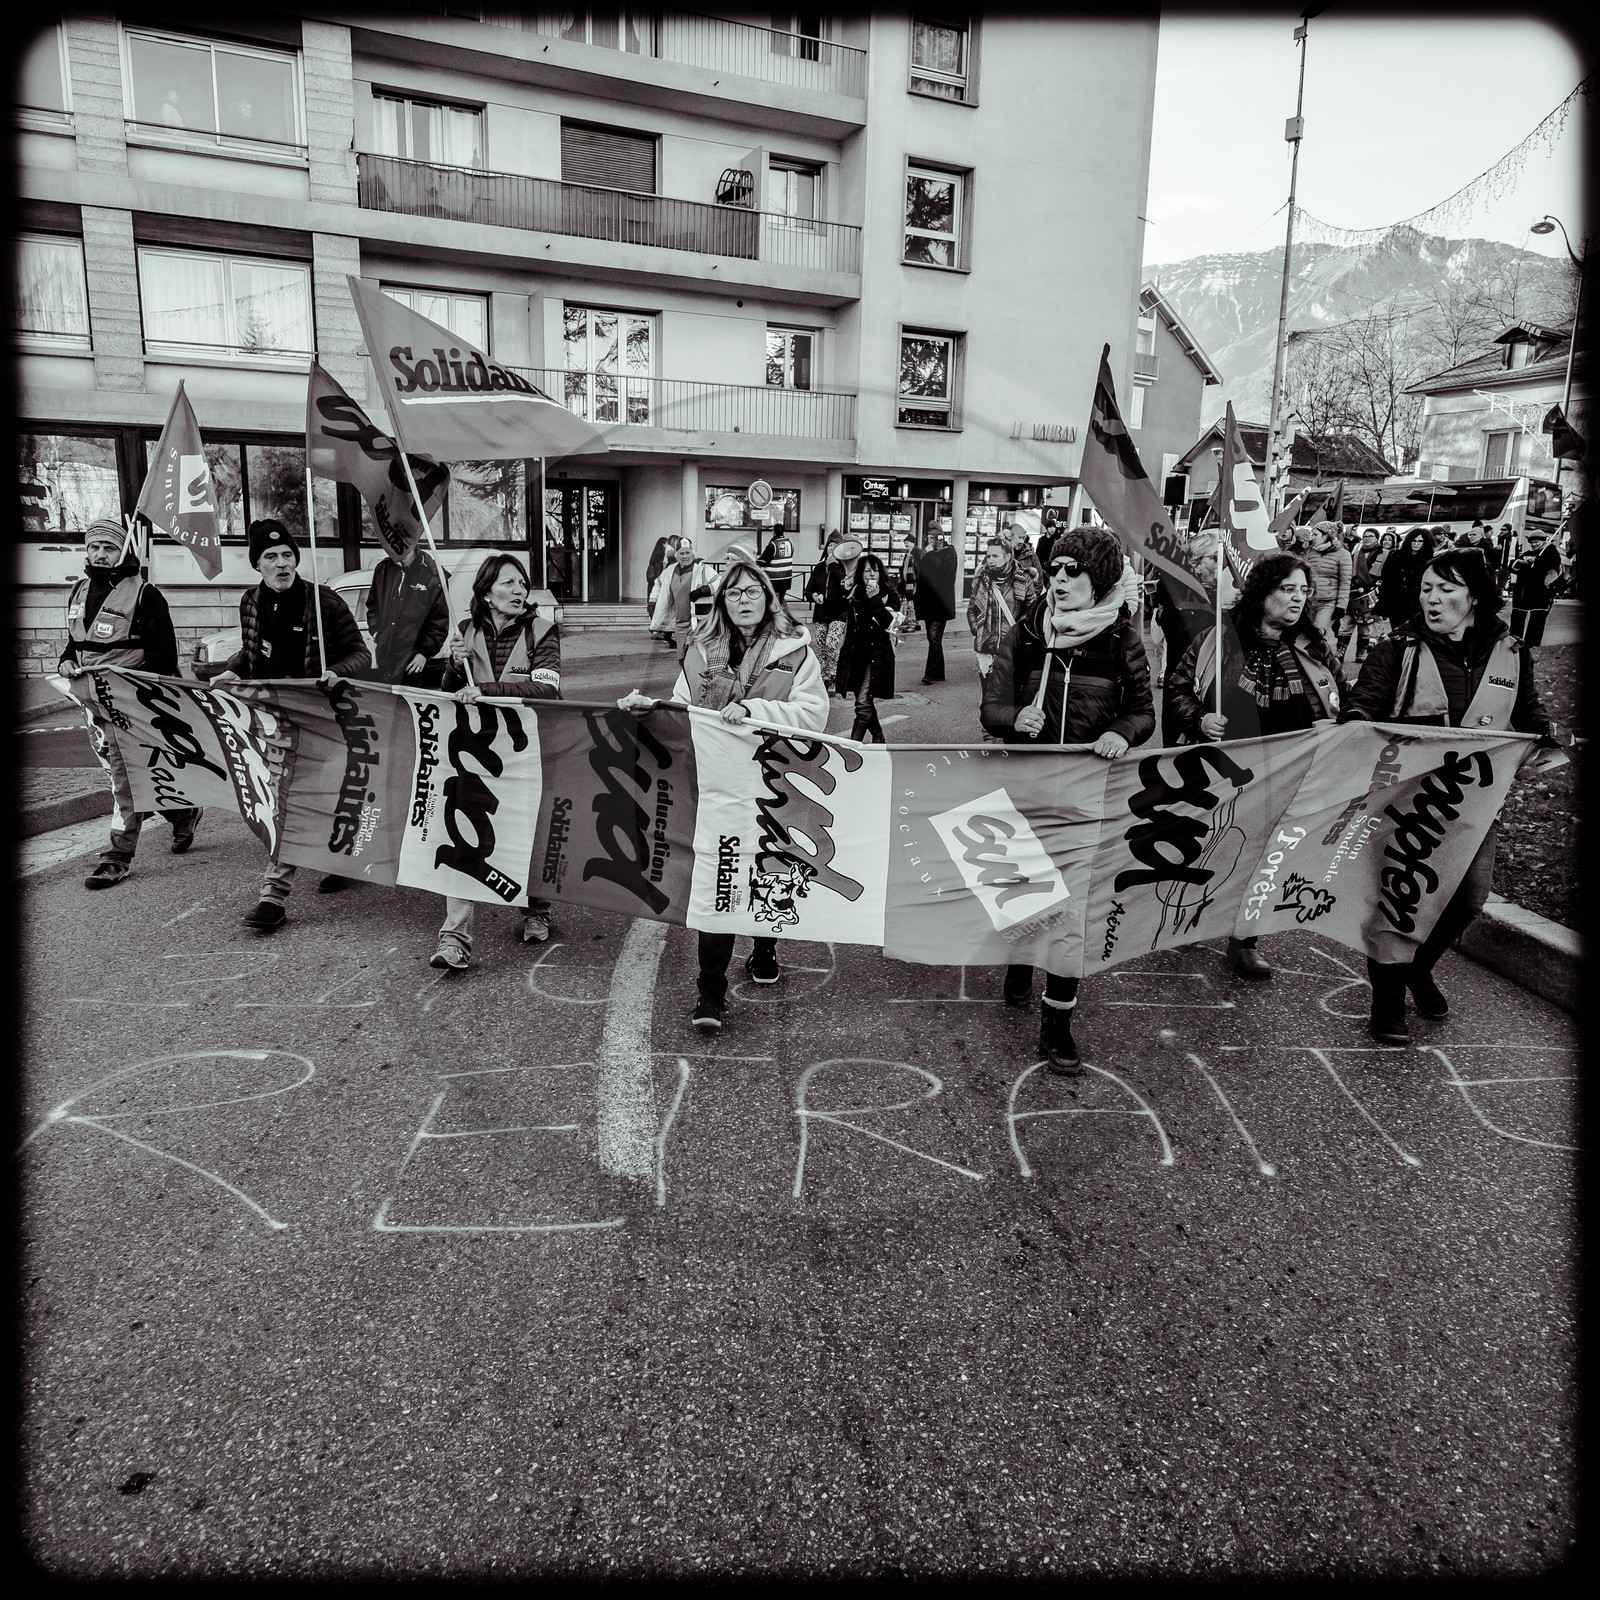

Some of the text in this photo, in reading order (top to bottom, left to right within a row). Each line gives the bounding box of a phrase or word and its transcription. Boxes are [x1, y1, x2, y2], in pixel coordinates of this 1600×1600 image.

[1009, 421, 1079, 444] LE VAUBAN
[863, 480, 889, 496] Century 21
[139, 743, 195, 807] Rail
[411, 702, 441, 829] Solidaires
[433, 700, 529, 902] Sud
[352, 805, 371, 858] syndicale
[364, 806, 382, 843] Union
[541, 796, 573, 885] Solidaires
[582, 709, 673, 915] Sud
[650, 778, 674, 883] éducation
[1114, 745, 1255, 893] Sud
[1347, 816, 1383, 861] Union
[485, 869, 515, 897] PTT
[715, 834, 741, 913] Solidaires
[951, 814, 1056, 910] Sud
[14, 1043, 1586, 1237] RETRAITE
